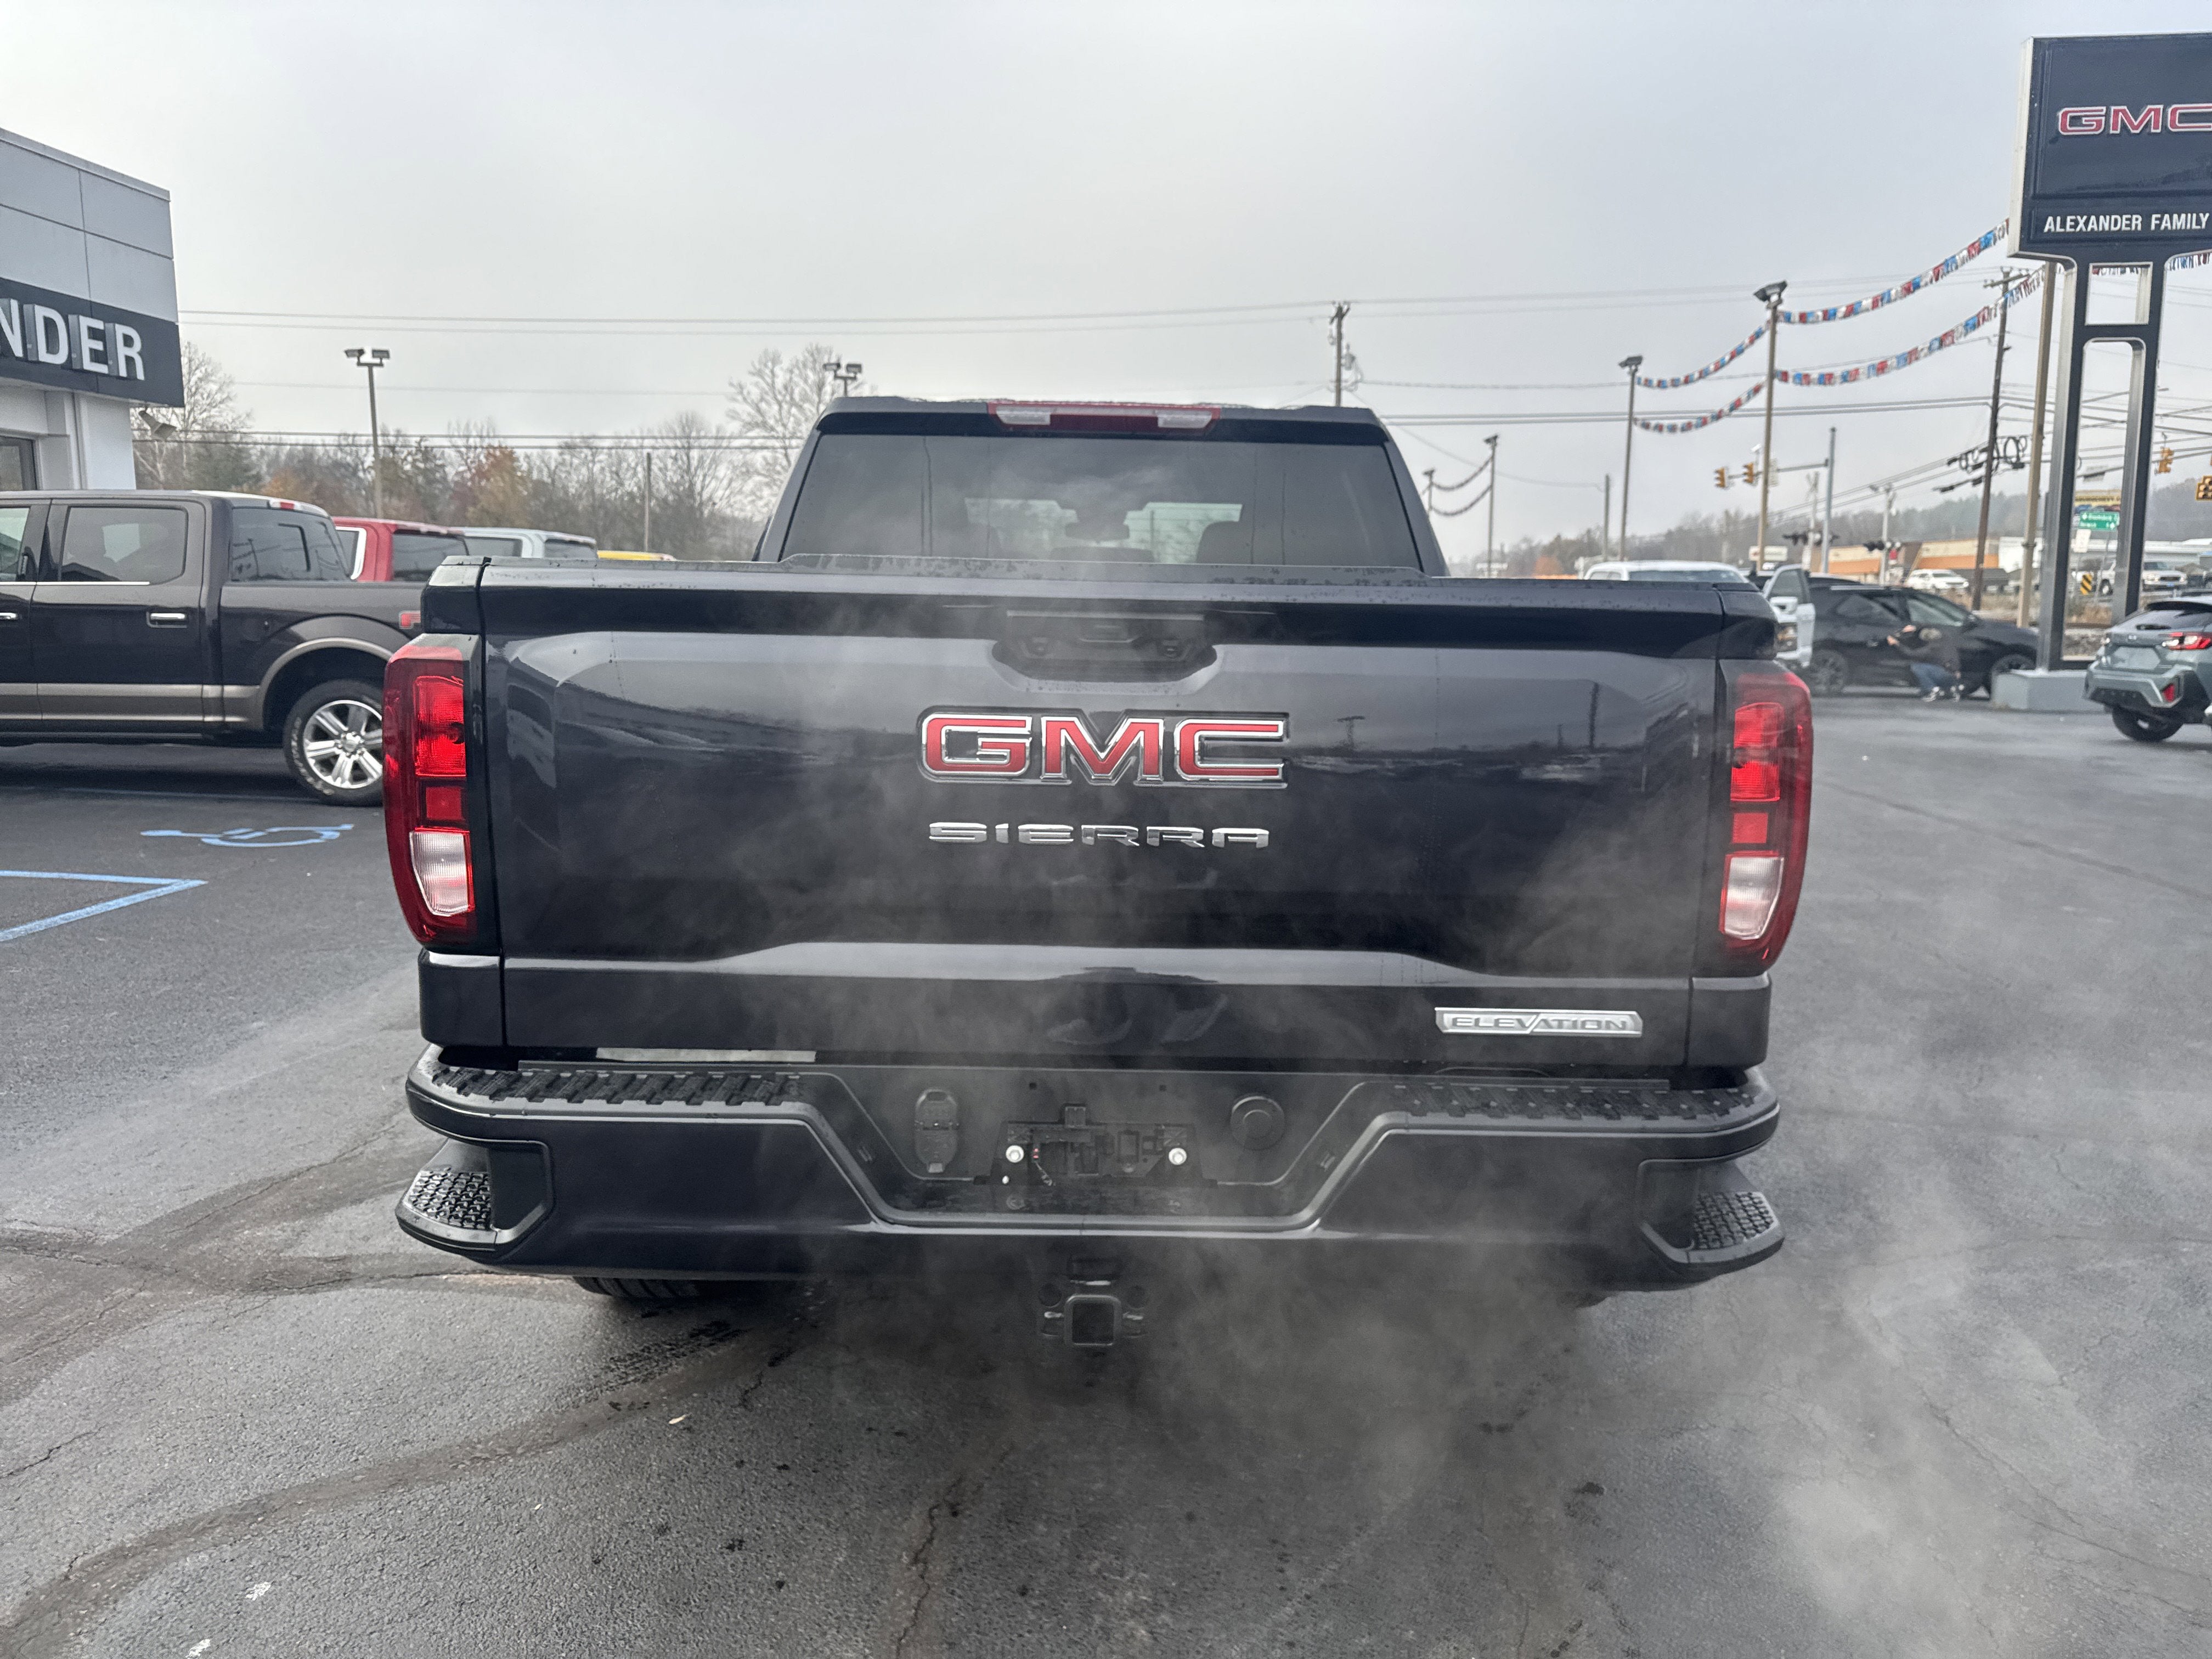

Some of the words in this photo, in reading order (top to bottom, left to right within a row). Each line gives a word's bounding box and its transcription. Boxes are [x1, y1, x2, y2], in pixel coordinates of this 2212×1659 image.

[2058, 103, 2212, 136] GMC
[2044, 215, 2142, 233] ALEXANDER
[2151, 212, 2209, 231] FAMILY
[921, 714, 1285, 781] GMC
[929, 822, 1269, 847] SIERRA
[1451, 1014, 1629, 1031] ELEVATION
